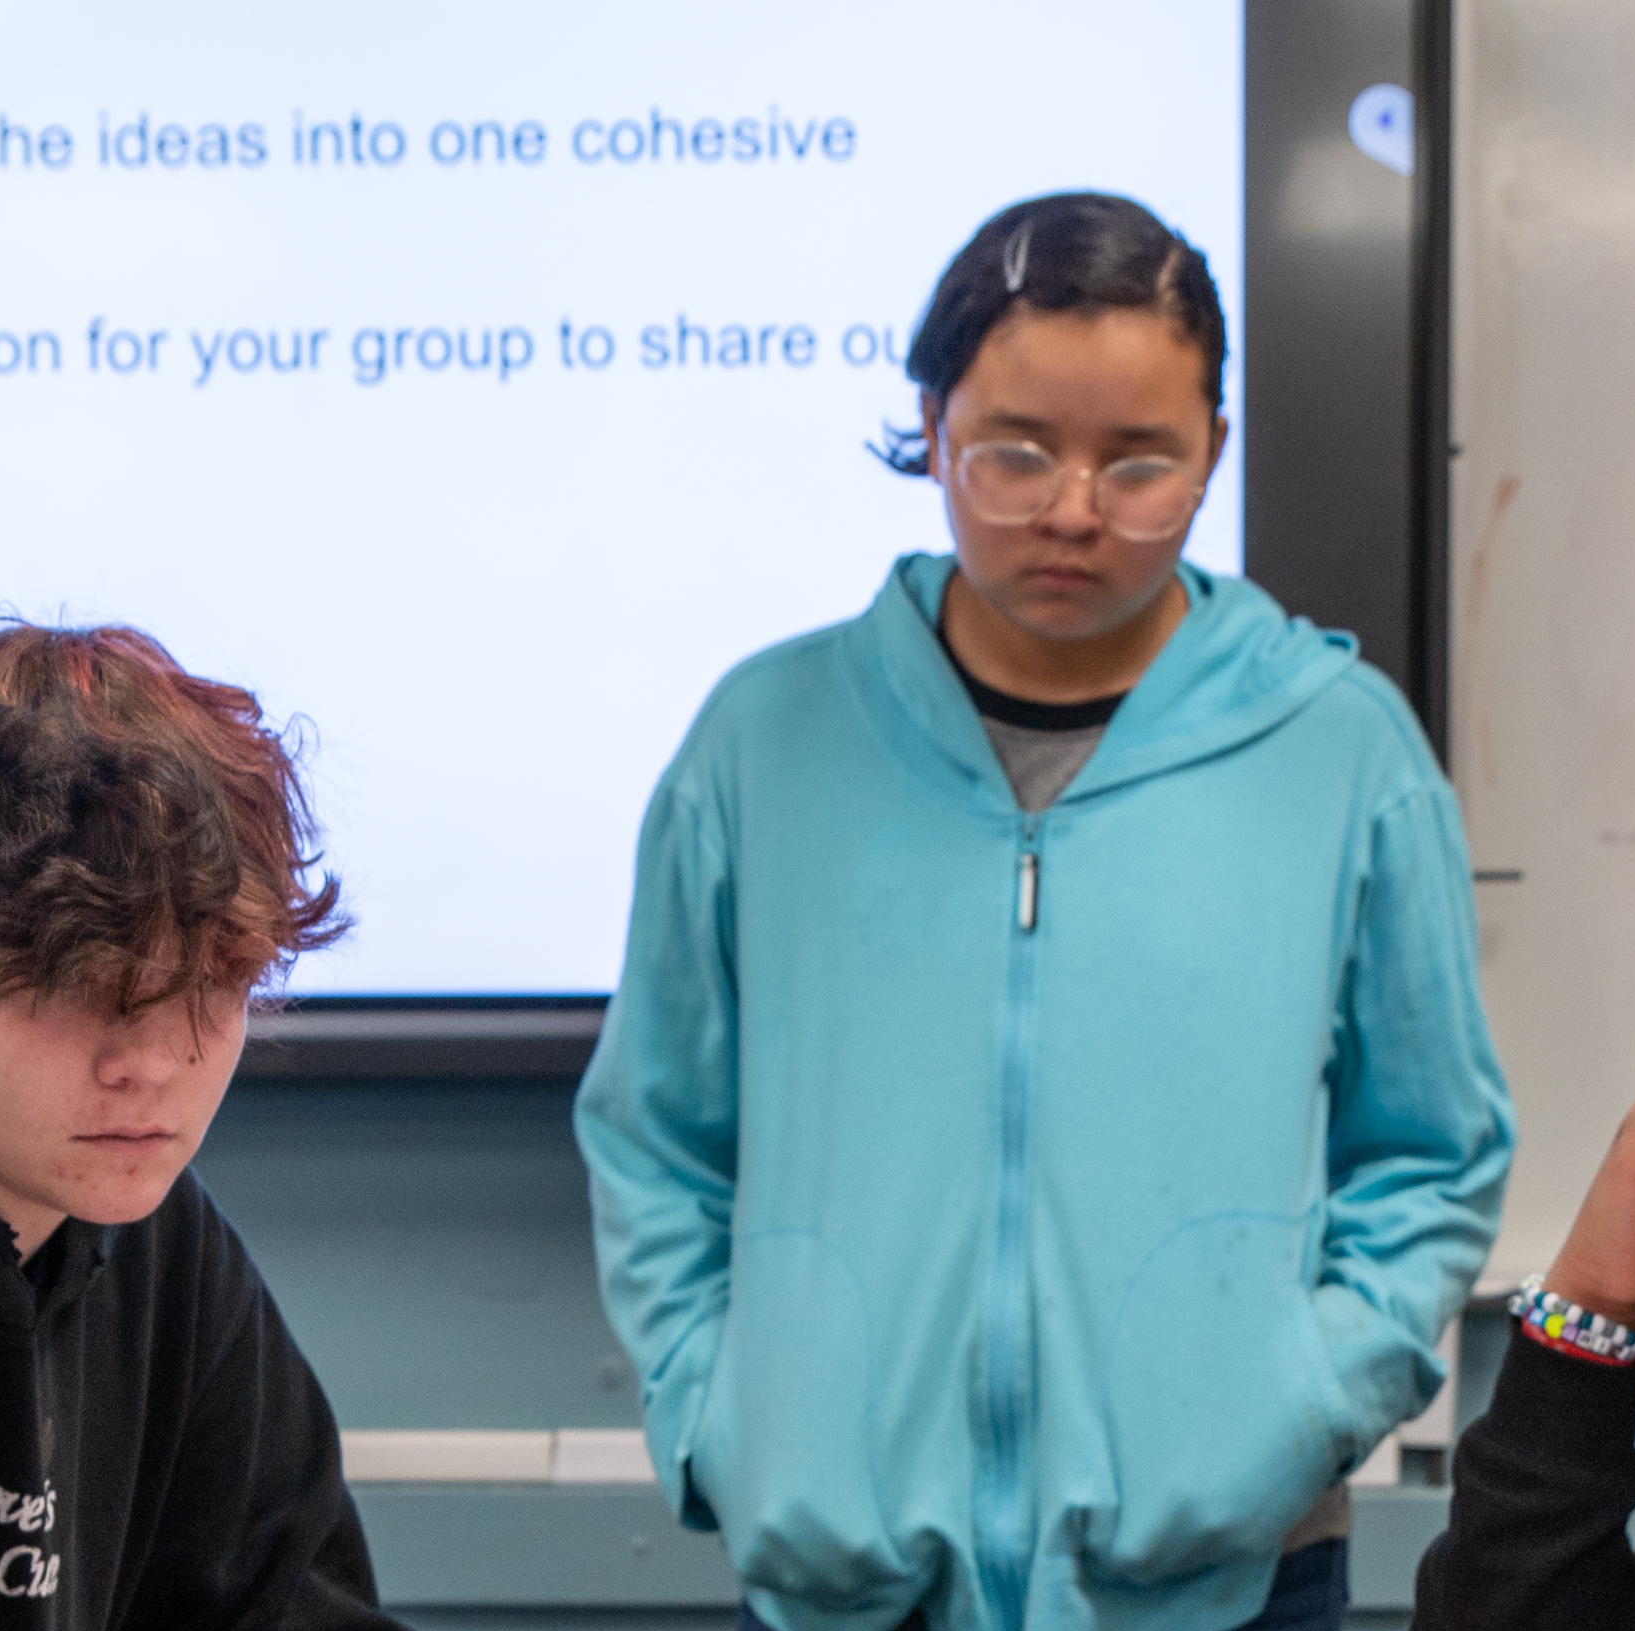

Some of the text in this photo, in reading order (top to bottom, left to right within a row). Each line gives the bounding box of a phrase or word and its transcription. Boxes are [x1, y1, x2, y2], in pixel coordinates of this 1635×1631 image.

[97, 111, 270, 170] ideas
[292, 109, 409, 168] into
[427, 119, 549, 167] one
[570, 105, 858, 166] cohesive
[85, 315, 169, 375] for
[189, 327, 330, 390] your
[350, 325, 536, 389] group
[557, 316, 617, 371] to
[639, 312, 819, 370] share
[840, 321, 907, 369] ou
